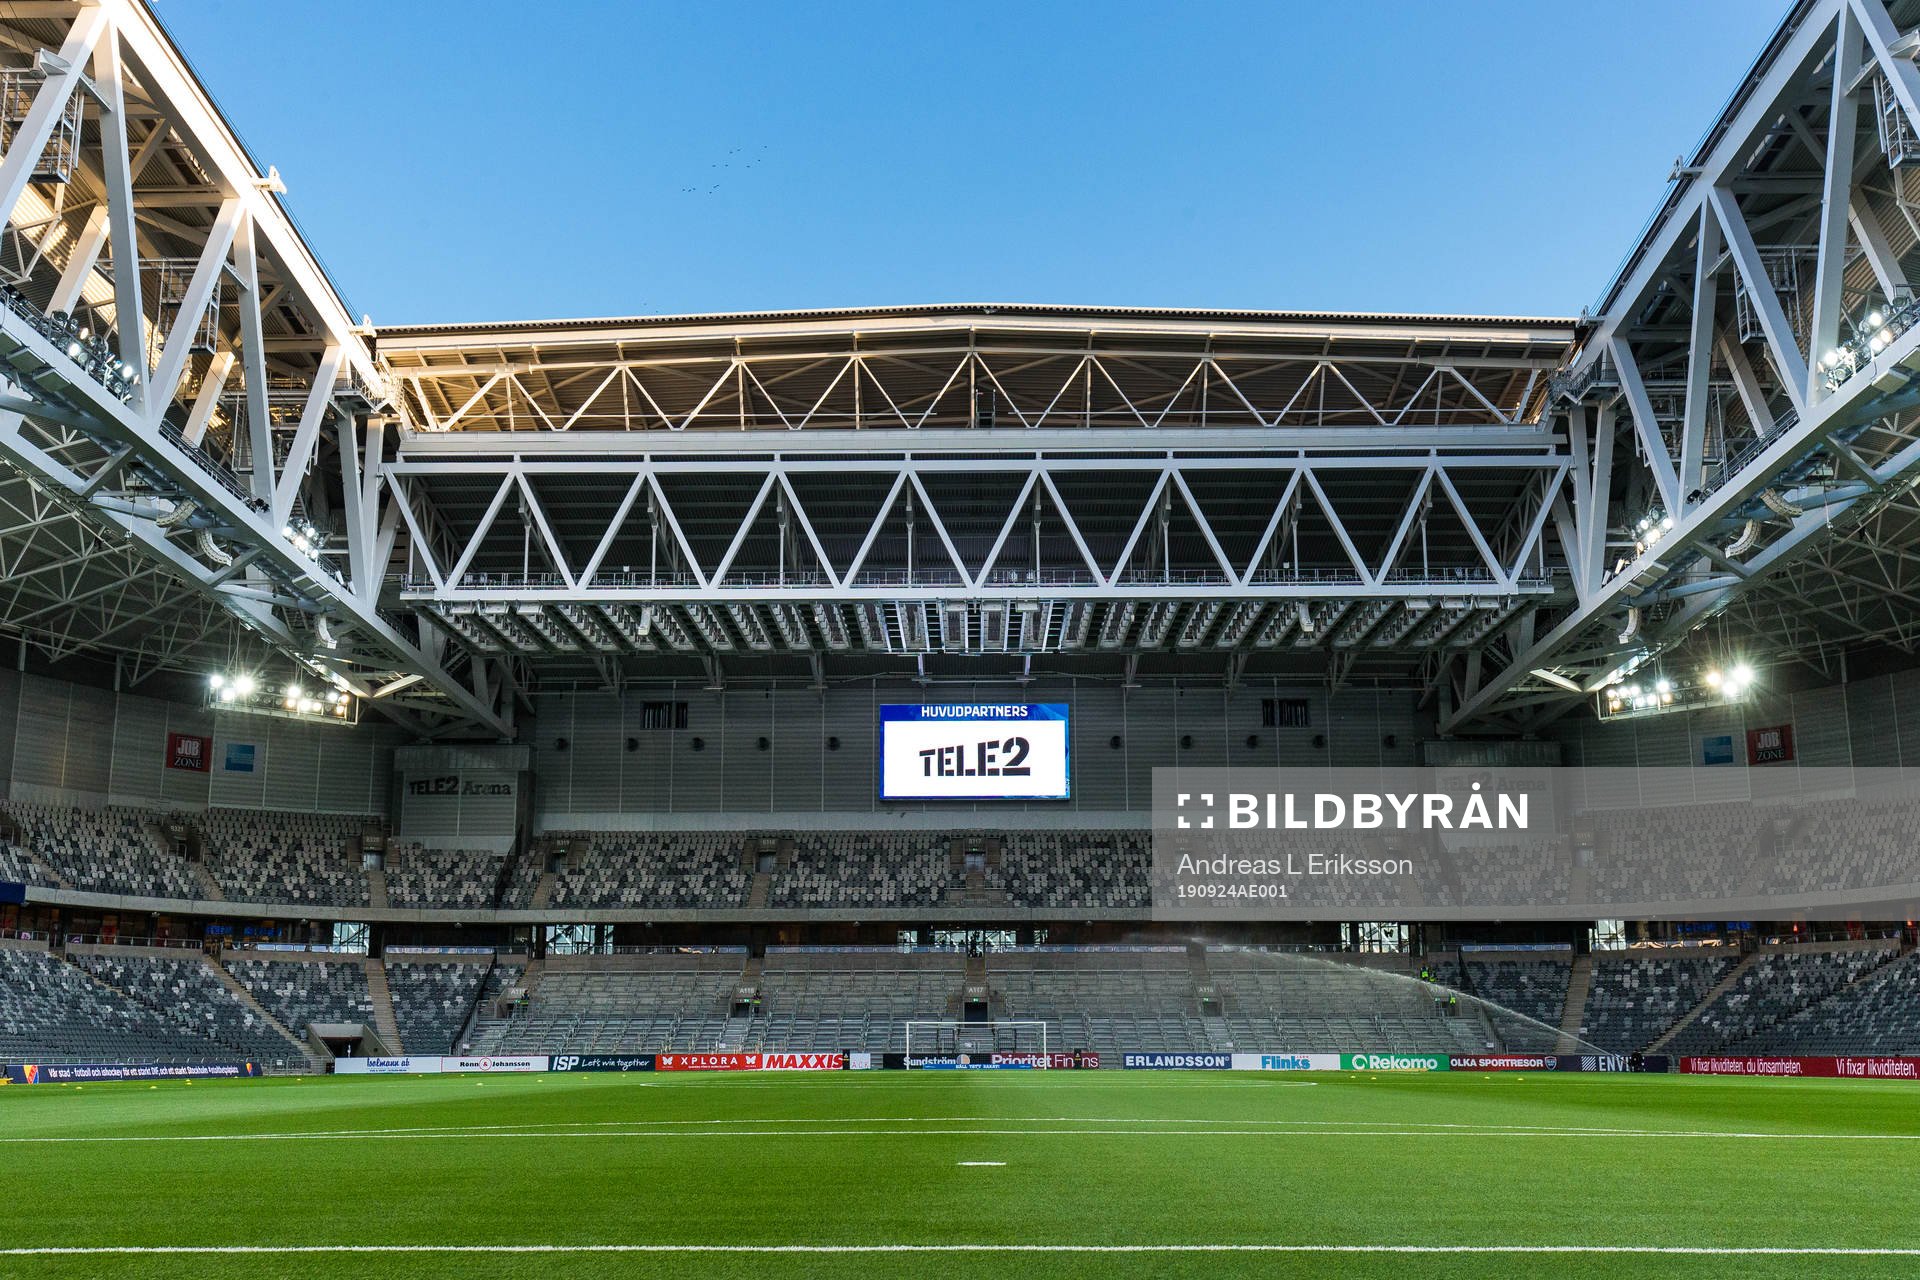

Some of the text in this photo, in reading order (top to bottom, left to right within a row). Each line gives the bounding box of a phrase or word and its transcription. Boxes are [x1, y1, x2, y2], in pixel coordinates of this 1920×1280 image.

[921, 705, 1028, 717] HUVUDPARTNERS
[178, 738, 200, 756] JOB
[1758, 732, 1780, 748] JOB
[174, 755, 202, 769] ZONE
[919, 736, 1031, 776] TELE2
[1756, 749, 1785, 761] ZONE
[409, 775, 511, 796] TELE2 Arena
[552, 1056, 580, 1071] ISP
[581, 1058, 650, 1071] Let's win together
[680, 1056, 738, 1065] XPLORA
[765, 1054, 844, 1069] MAXXIS
[1054, 1054, 1099, 1068] Finns
[1125, 1055, 1225, 1067] ERLANDSSON
[1261, 1055, 1311, 1069] Flinks
[1369, 1055, 1438, 1070] Rekomo
[1450, 1058, 1476, 1068] OLKA
[1478, 1057, 1543, 1068] SPORTRESOR
[1747, 1059, 1756, 1073] du
[1836, 1058, 1845, 1074] Vi
[1846, 1058, 1866, 1076] fixar
[59, 1067, 70, 1078] stad
[91, 1066, 101, 1077] och
